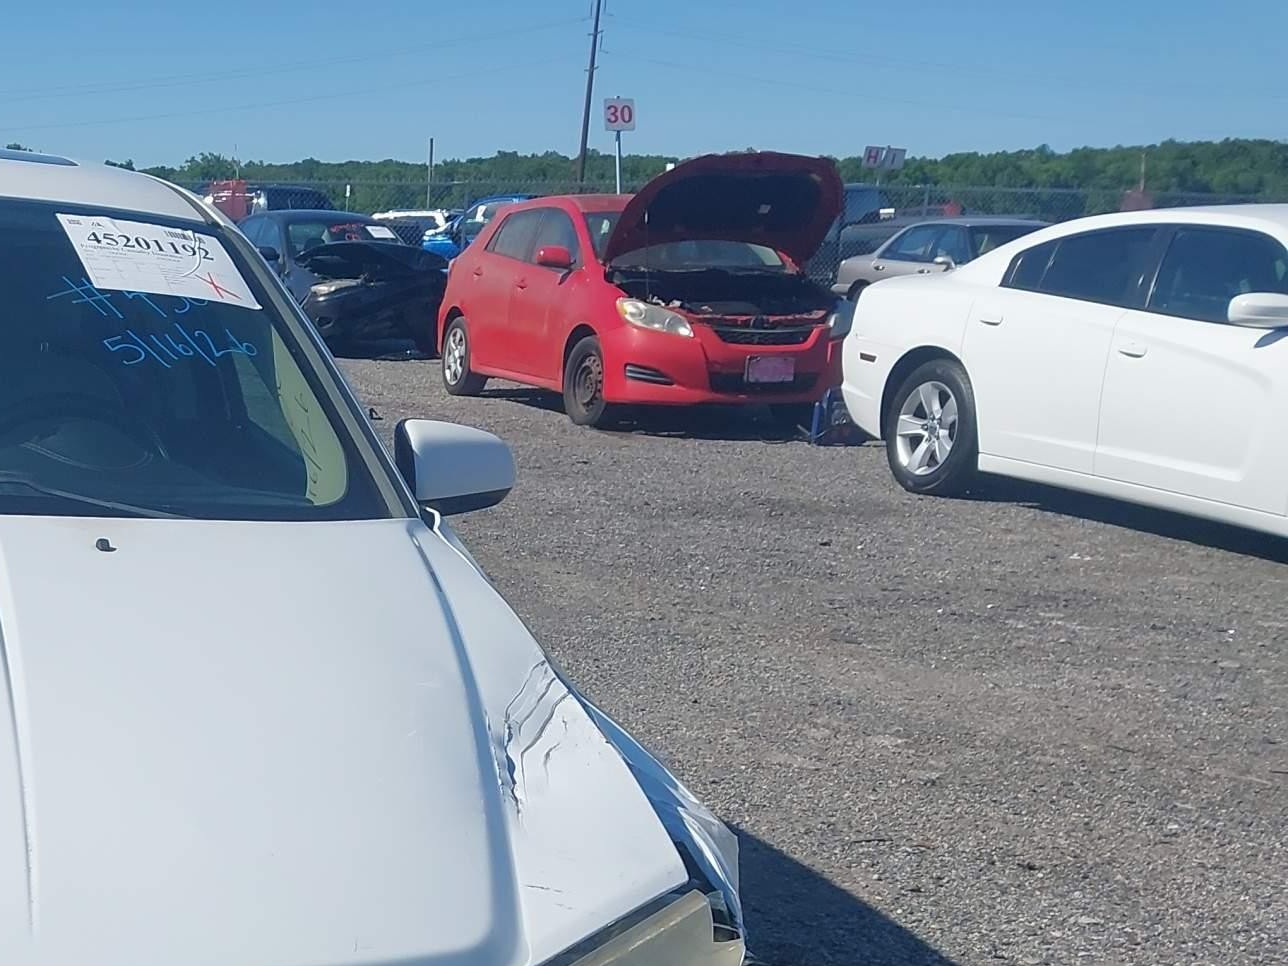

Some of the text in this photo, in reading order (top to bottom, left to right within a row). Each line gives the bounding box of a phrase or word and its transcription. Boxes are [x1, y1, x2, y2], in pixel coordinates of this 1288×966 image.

[606, 104, 633, 124] 30
[866, 149, 880, 165] H
[87, 230, 215, 262] 45201192
